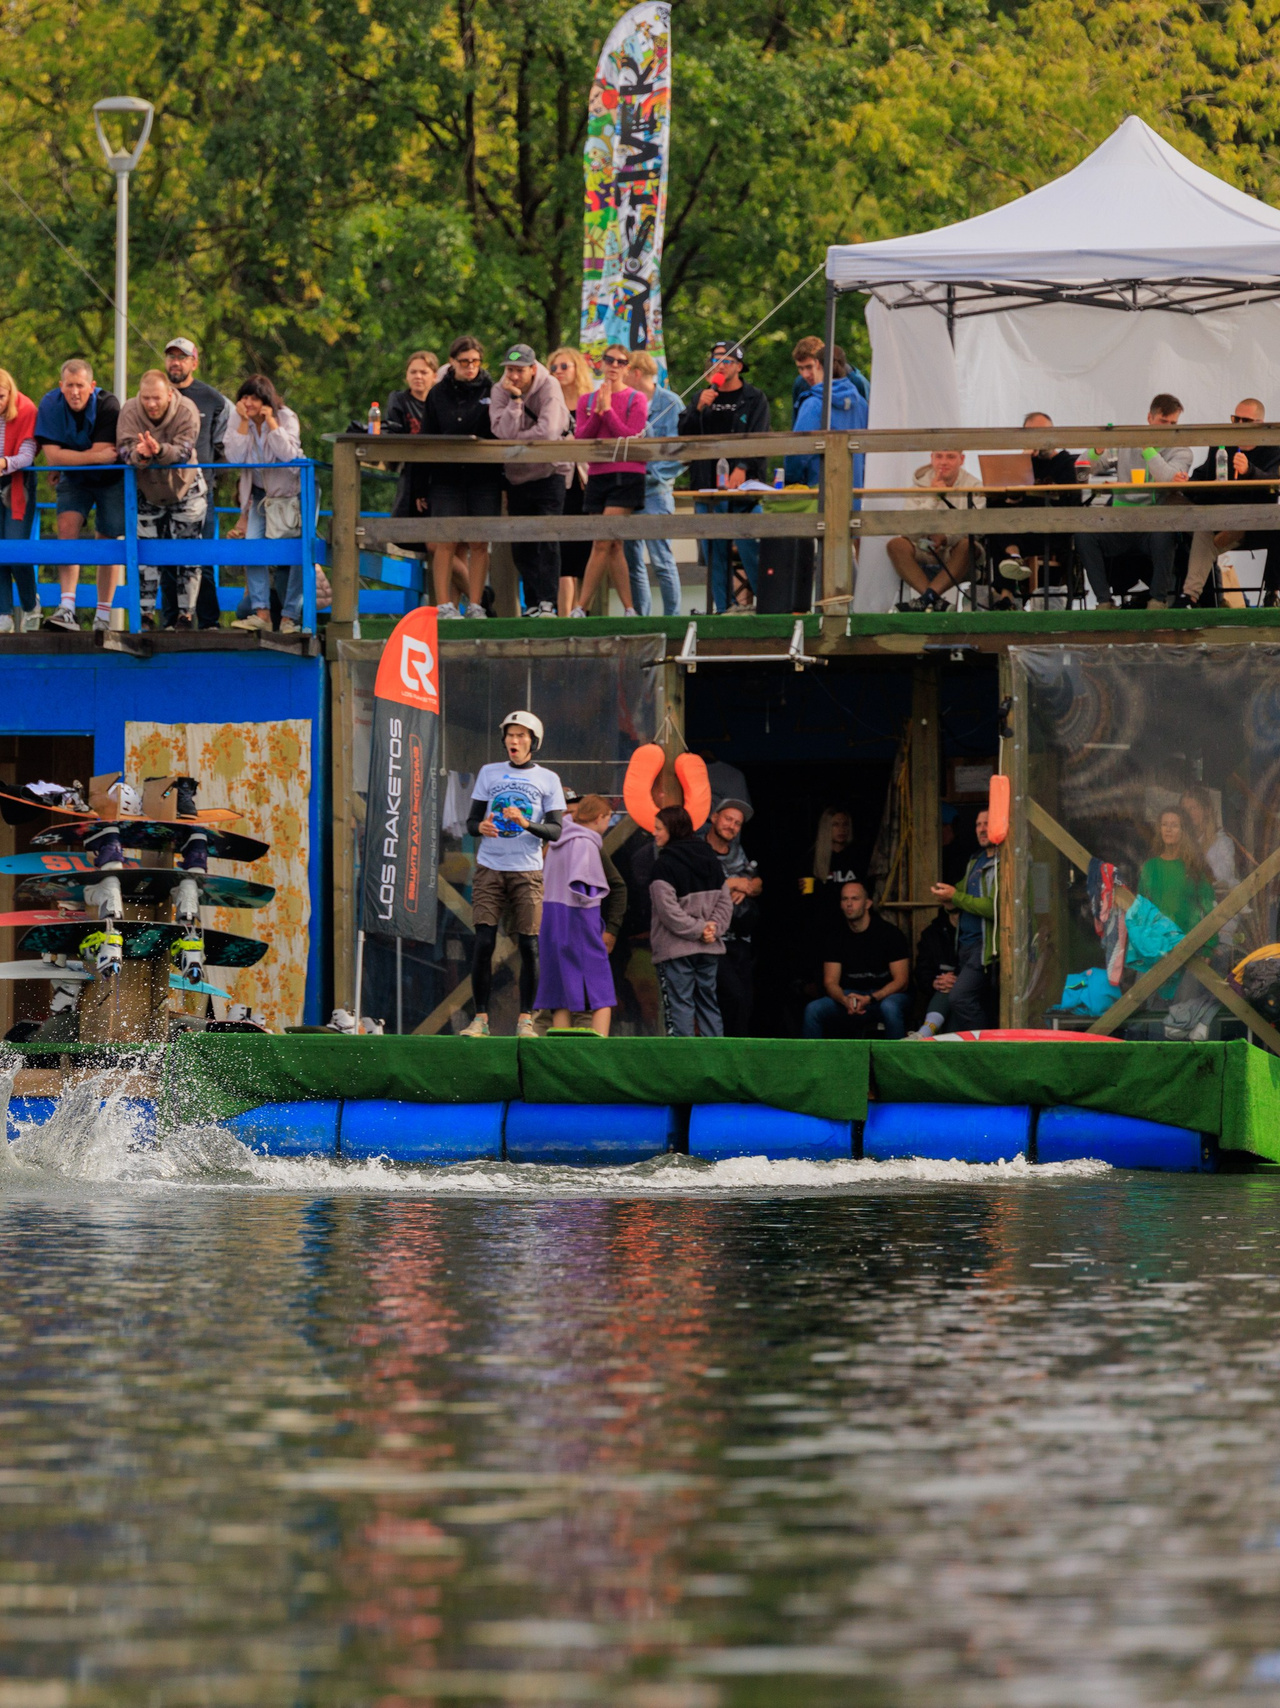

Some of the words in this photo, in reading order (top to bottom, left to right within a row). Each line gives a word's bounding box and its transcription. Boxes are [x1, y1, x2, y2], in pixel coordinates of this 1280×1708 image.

[383, 718, 402, 858] RAKETOS
[378, 864, 397, 920] LOS
[827, 870, 857, 882] ILA
